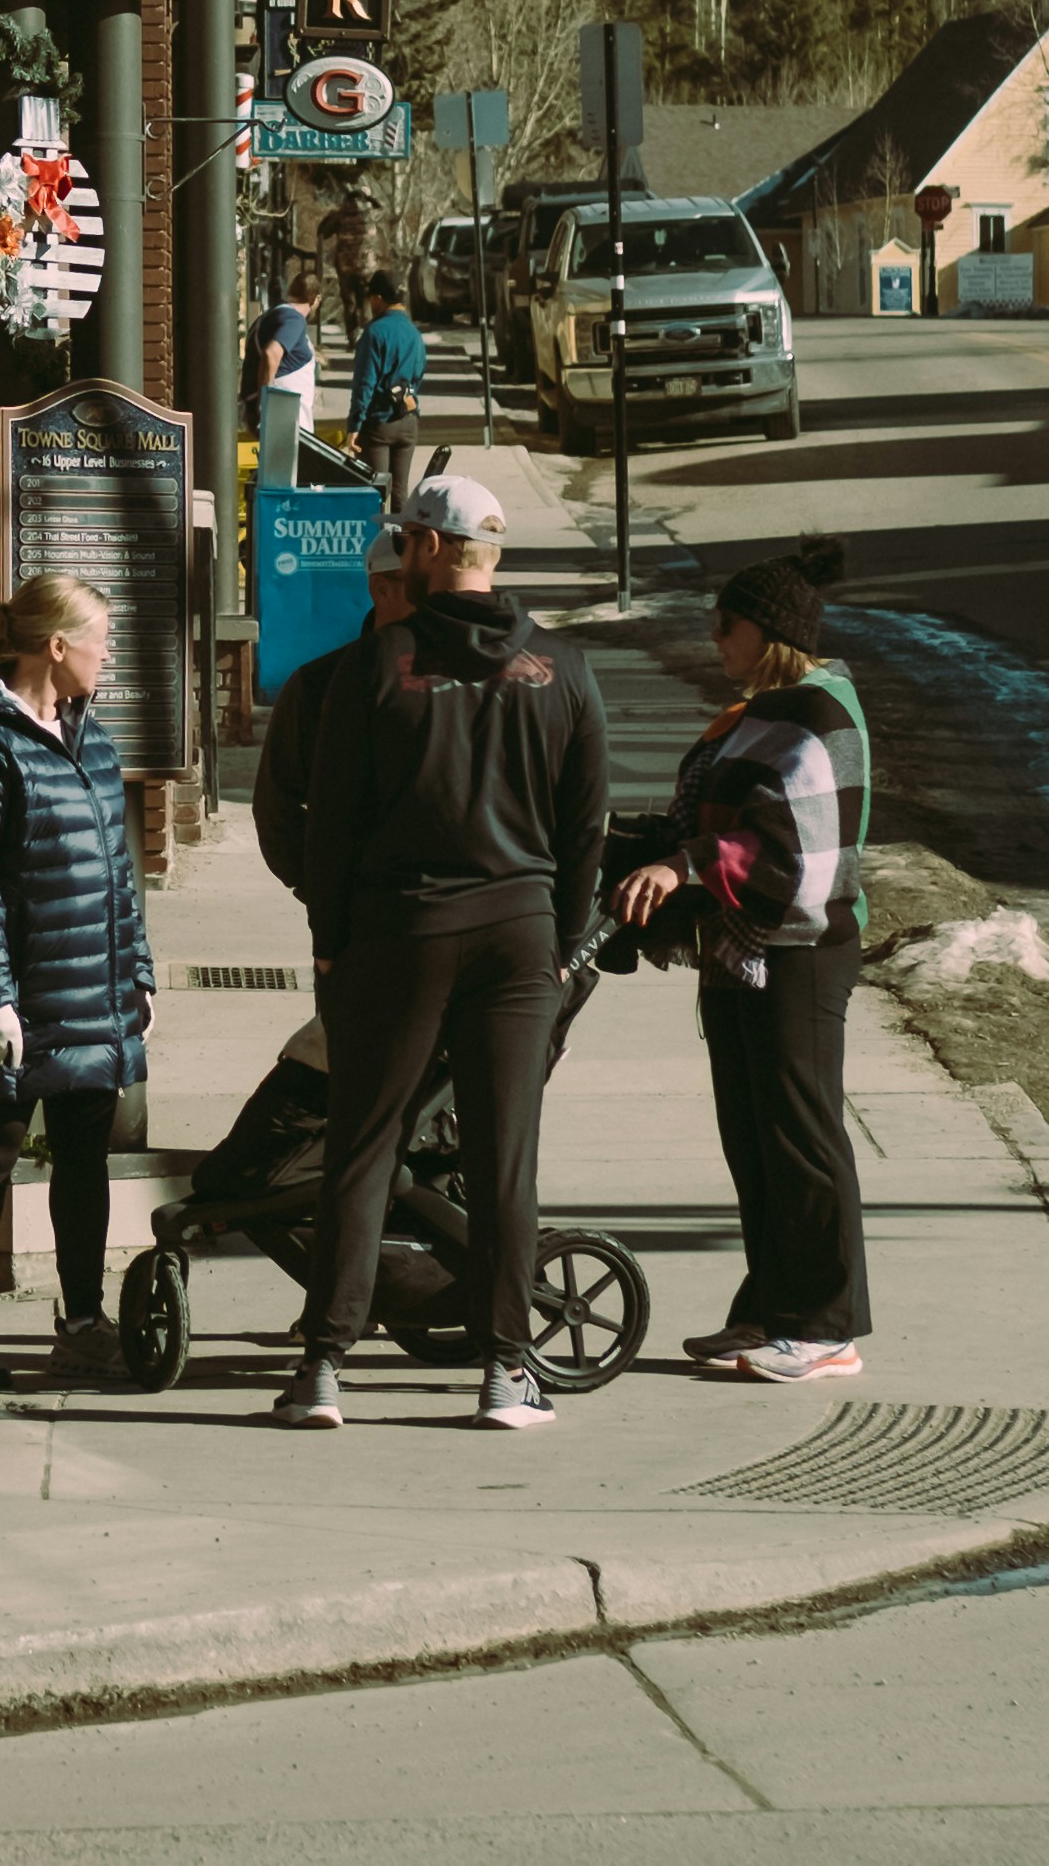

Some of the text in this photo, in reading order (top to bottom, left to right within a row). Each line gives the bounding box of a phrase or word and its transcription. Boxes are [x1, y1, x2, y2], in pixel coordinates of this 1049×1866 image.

[310, 69, 365, 117] G
[259, 121, 369, 151] BARBER
[917, 196, 949, 211] STOP
[18, 427, 180, 452] TOWNE SQUARE MALL
[53, 455, 81, 471] Upper
[84, 455, 106, 468] Level
[109, 456, 155, 469] Businesses
[27, 479, 40, 487] 201
[274, 517, 366, 538] SUMMIT
[27, 550, 41, 559] 205
[300, 537, 366, 555] DAILY
[565, 930, 610, 979] UAVA
